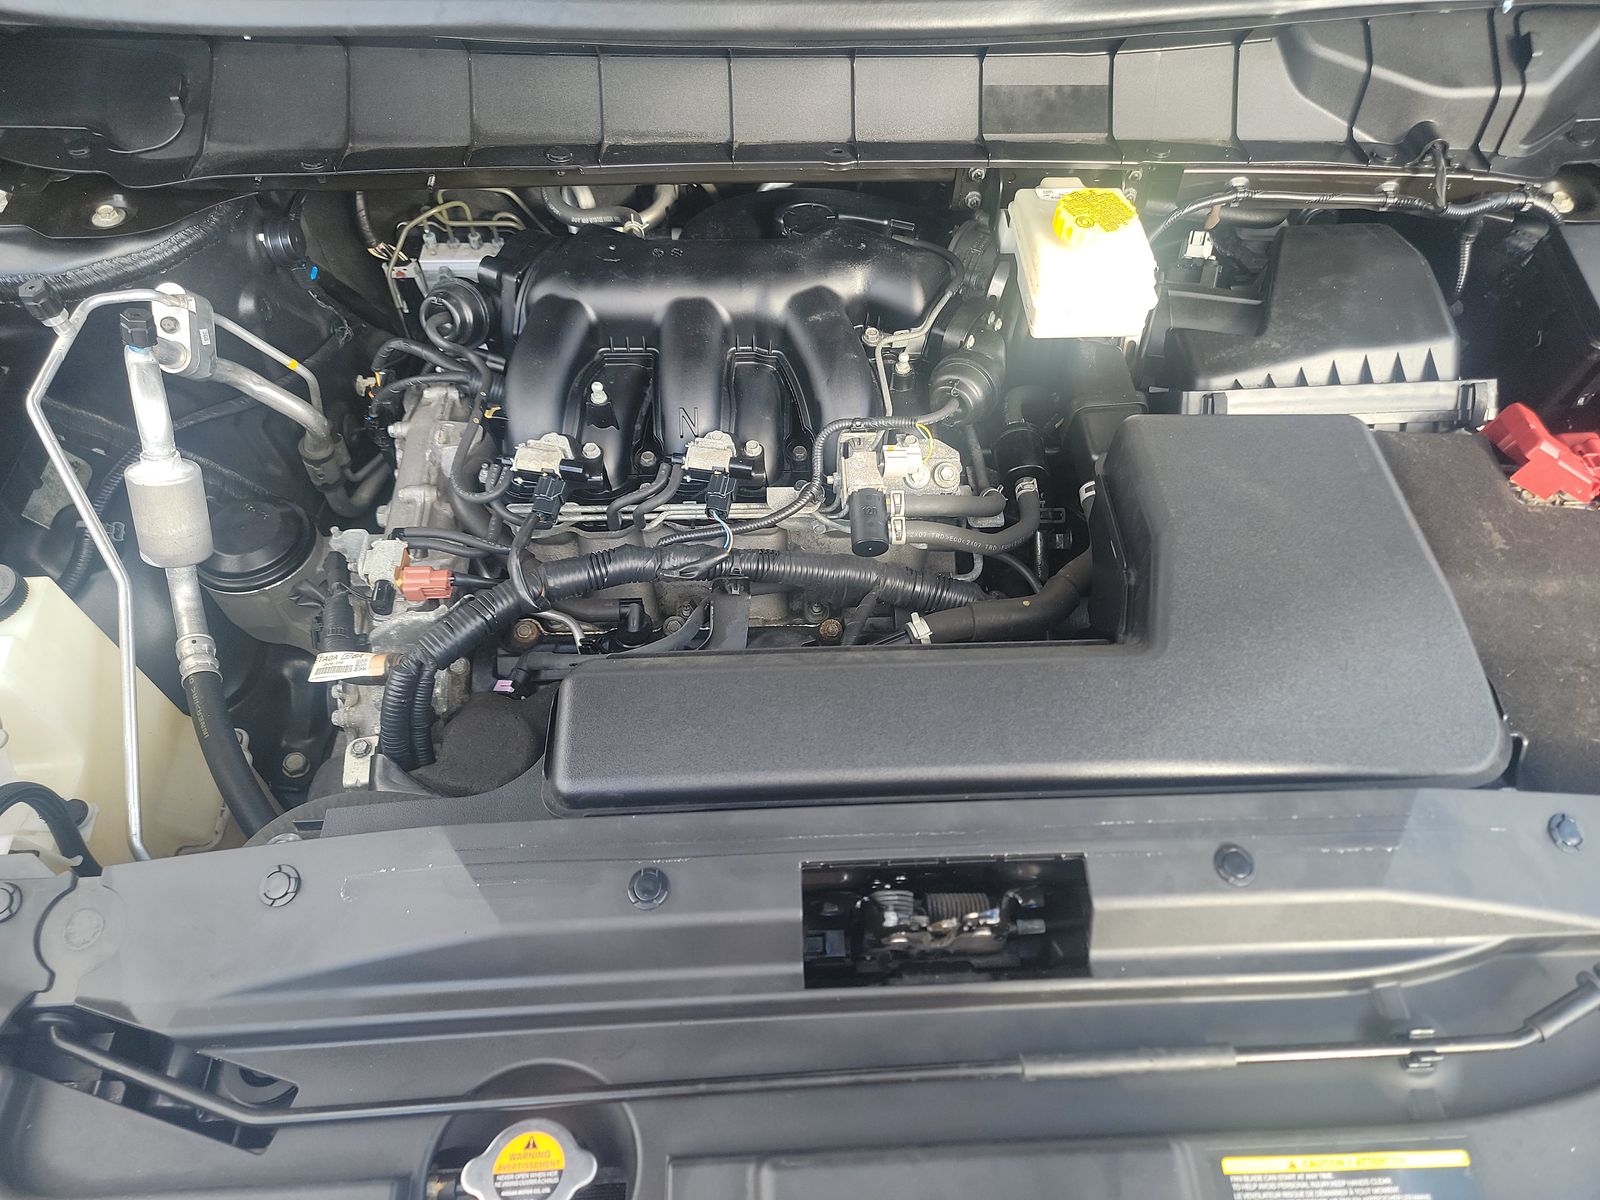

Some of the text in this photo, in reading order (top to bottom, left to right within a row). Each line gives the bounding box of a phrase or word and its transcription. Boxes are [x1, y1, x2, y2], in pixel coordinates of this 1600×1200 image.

[679, 406, 699, 438] N
[509, 1150, 551, 1161] WARNING
[497, 1160, 560, 1171] AVERTISSEMENT
